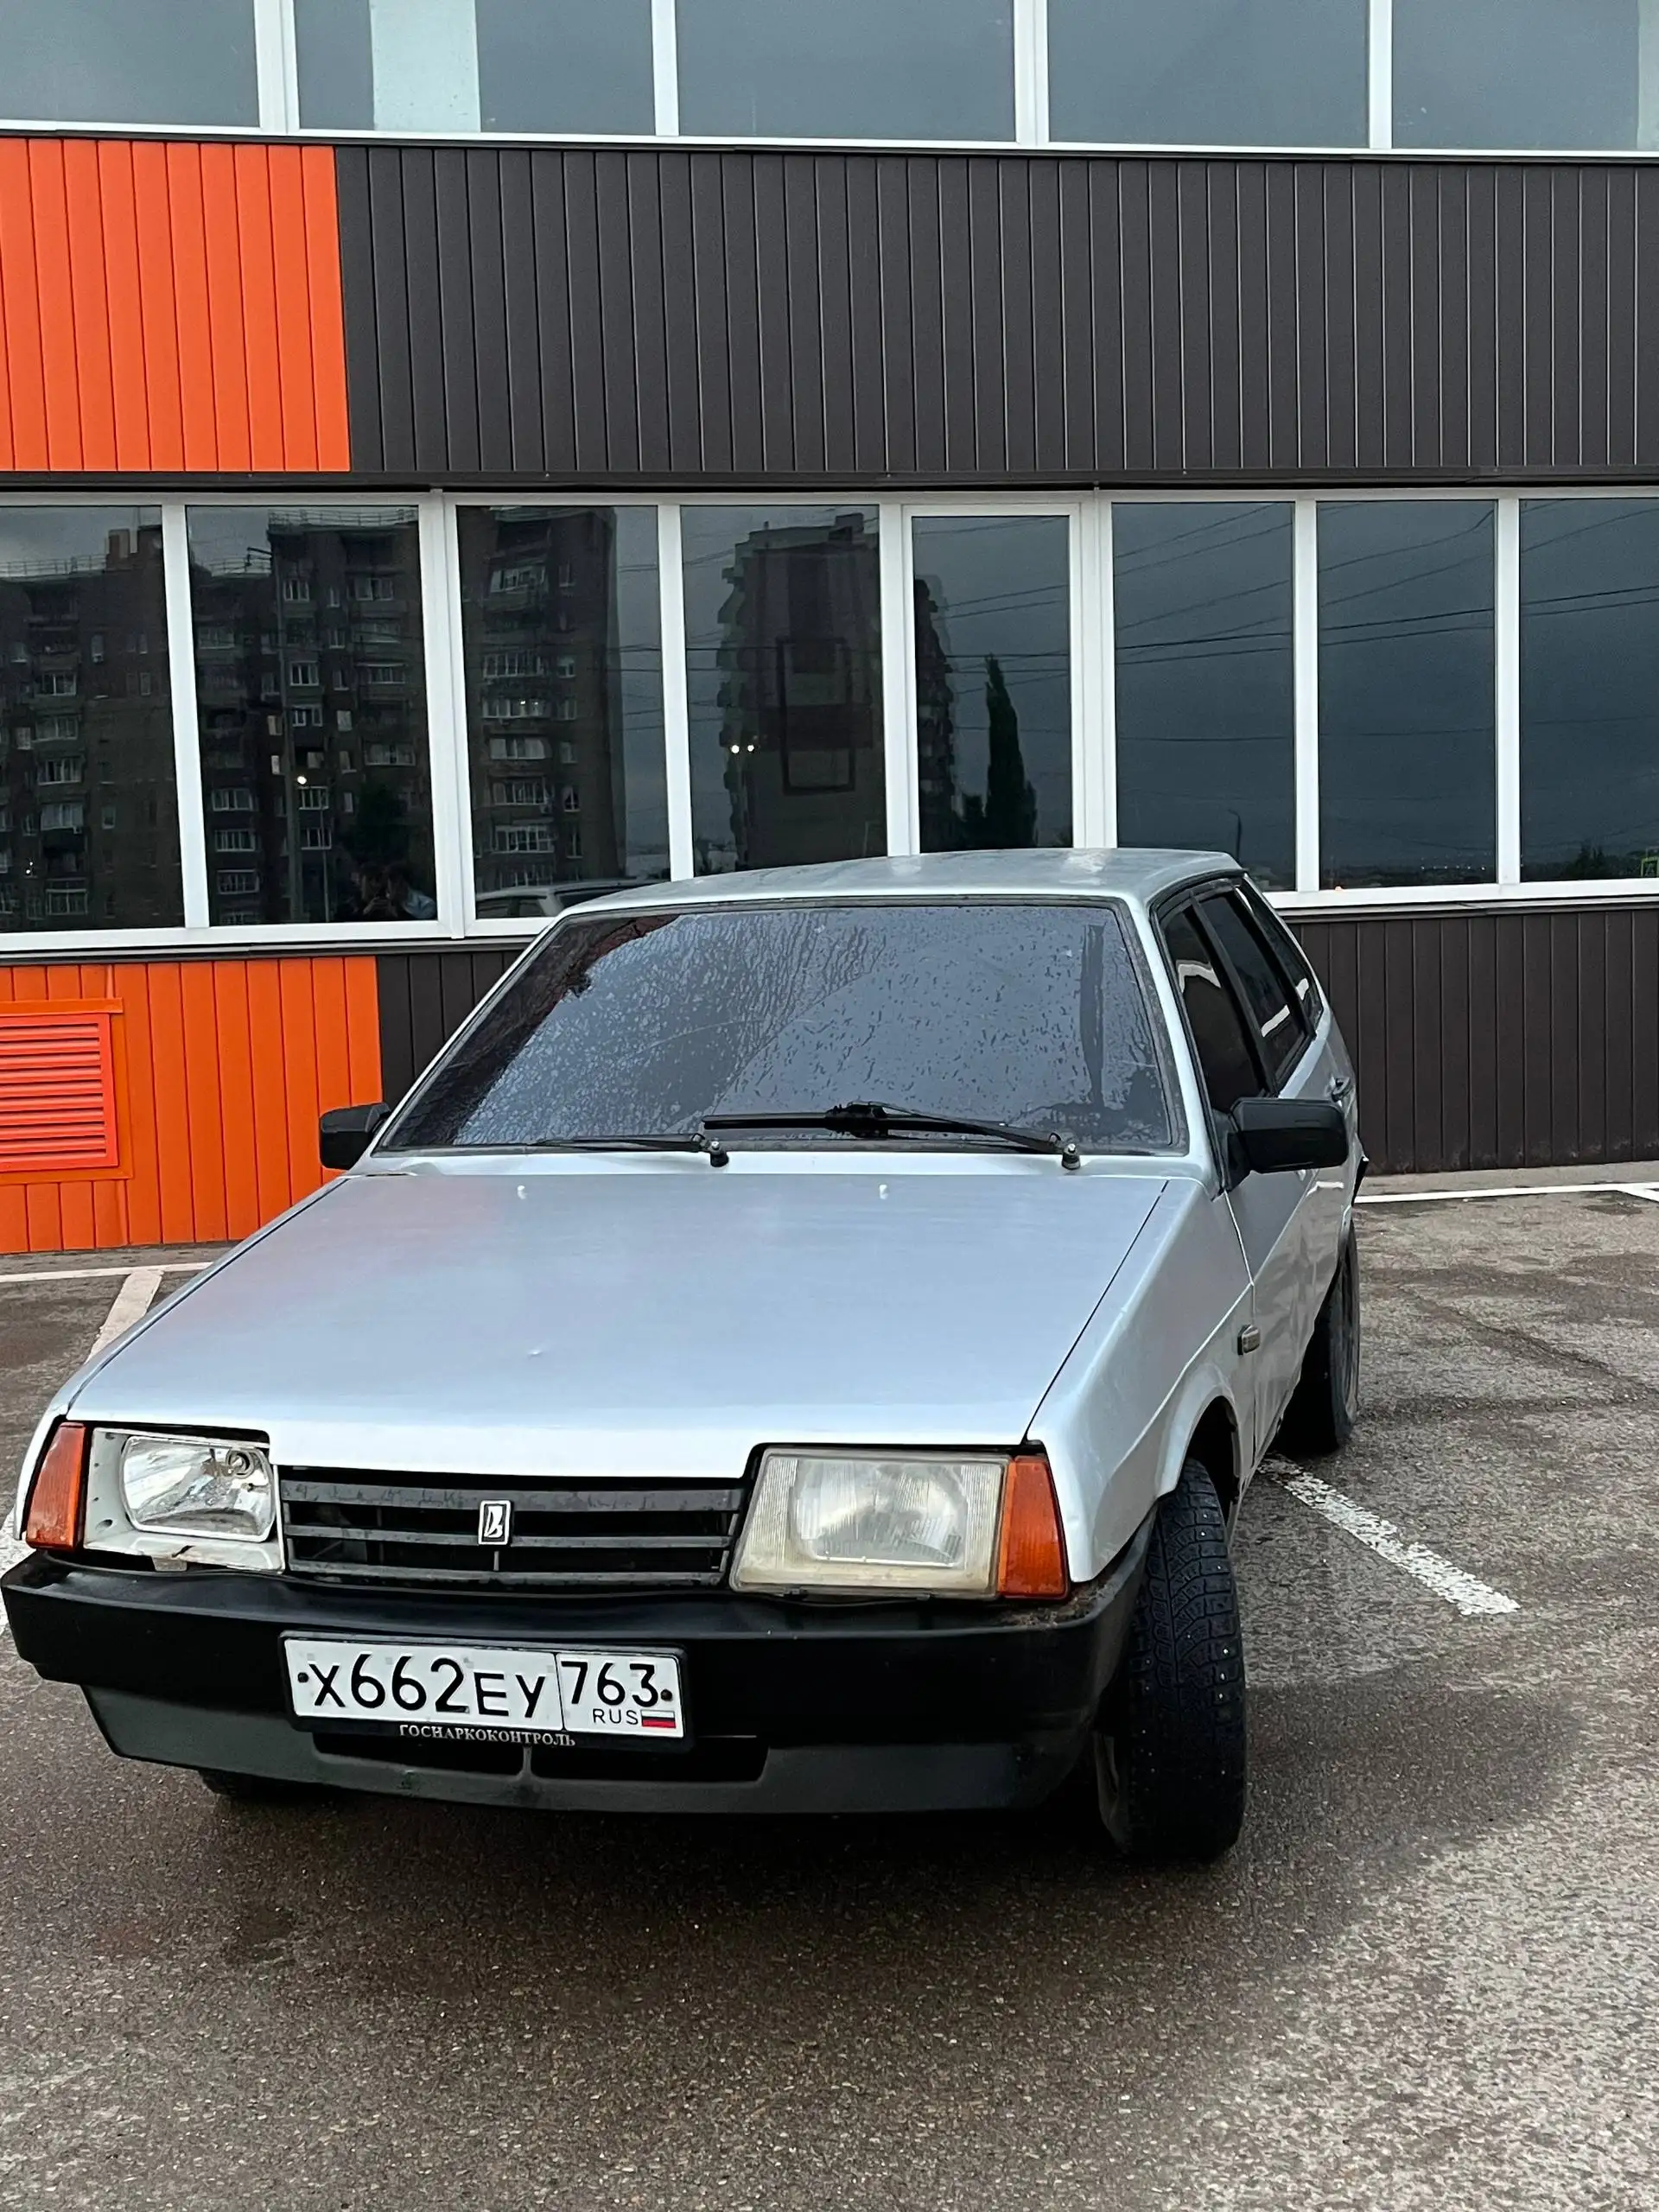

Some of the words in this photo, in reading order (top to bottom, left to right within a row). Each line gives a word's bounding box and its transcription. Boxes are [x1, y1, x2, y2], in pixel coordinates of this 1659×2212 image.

[308, 1653, 546, 1719] Х662ЕУ
[561, 1660, 659, 1708] 763
[592, 1708, 639, 1726] RUS
[399, 1724, 575, 1746] ГОСНАРКОКОНТРОЛЬ
